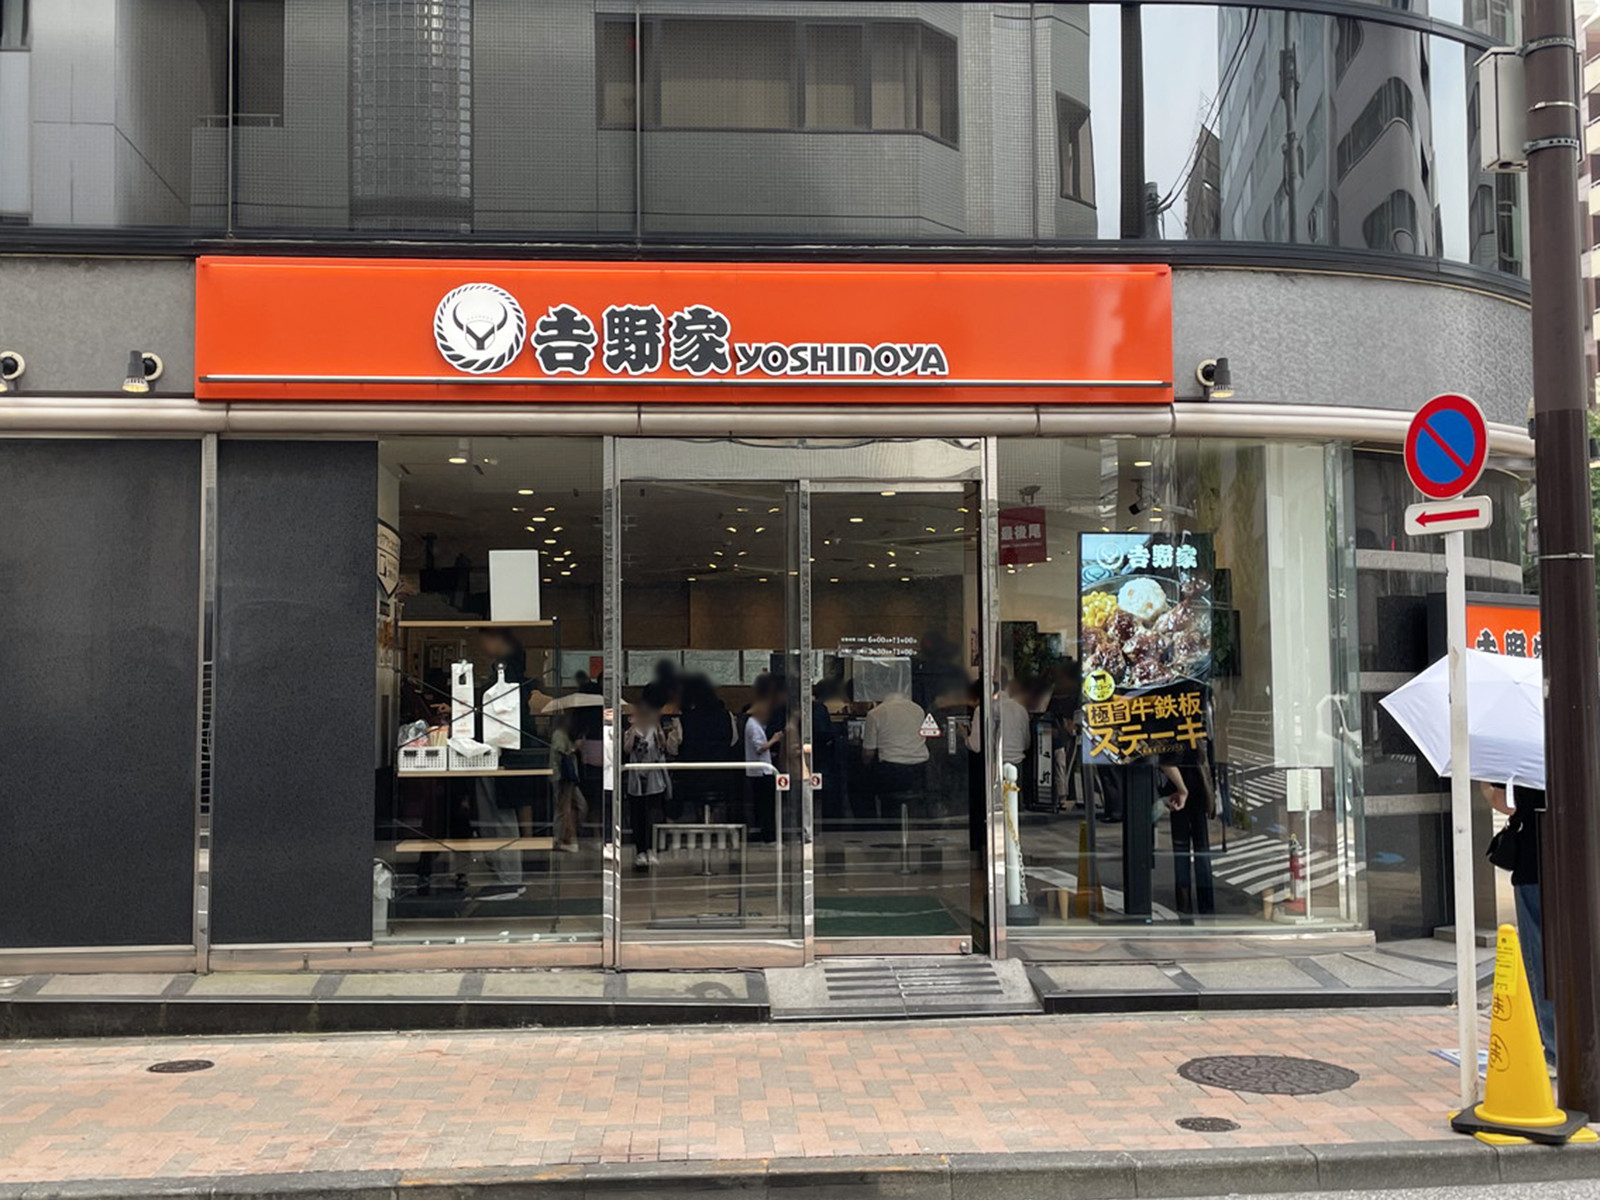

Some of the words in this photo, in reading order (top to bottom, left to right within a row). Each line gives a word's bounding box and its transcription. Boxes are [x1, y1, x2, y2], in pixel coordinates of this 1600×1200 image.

[735, 343, 949, 376] YOSHINOYA
[1089, 717, 1208, 757] ステーキ
